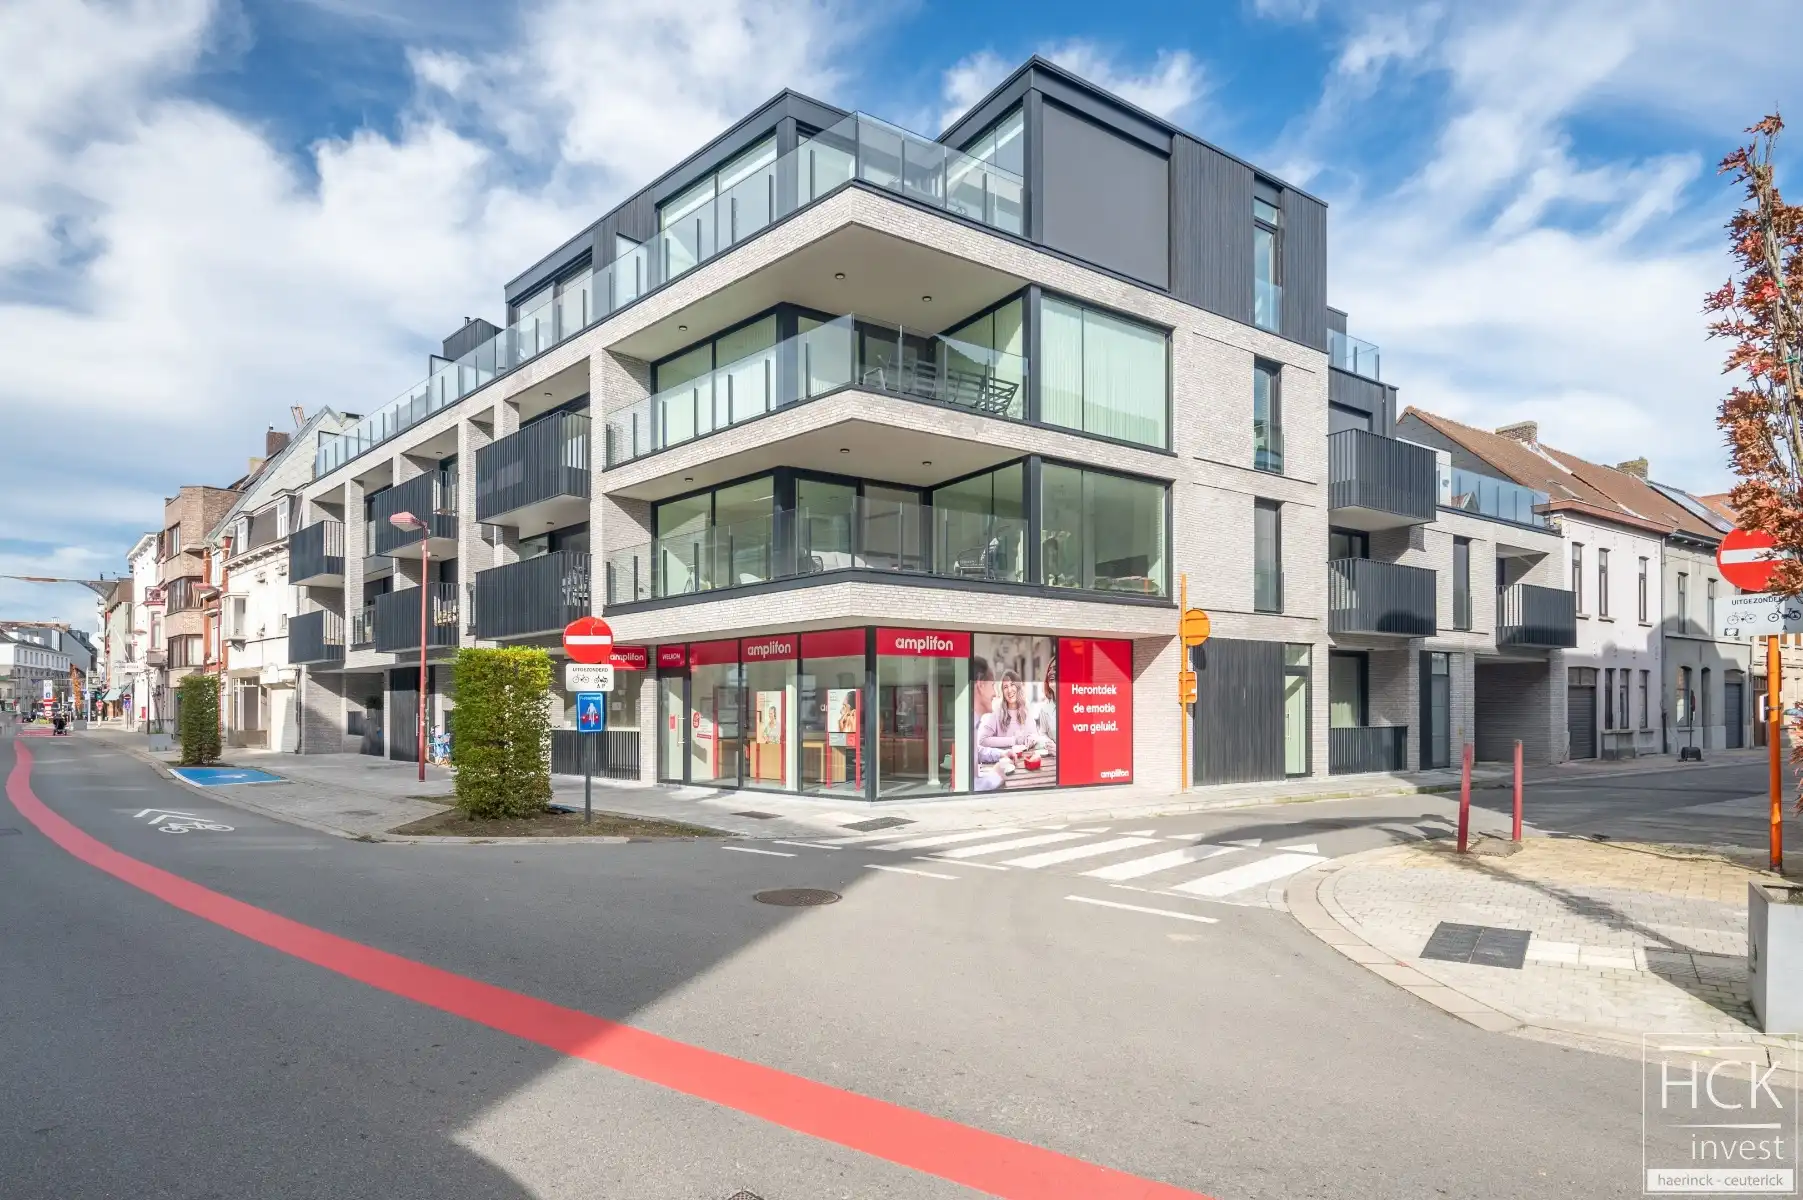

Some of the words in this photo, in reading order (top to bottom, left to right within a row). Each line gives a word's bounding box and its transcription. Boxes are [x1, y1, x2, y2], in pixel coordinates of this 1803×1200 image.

[1731, 595, 1789, 606] UITGEZONDED
[747, 640, 791, 658] amplifon
[895, 635, 954, 654] amplifon
[609, 650, 644, 663] amplifon
[1071, 684, 1117, 695] Herontdek
[1073, 703, 1085, 713] de
[1086, 703, 1116, 713] emotie
[1072, 723, 1089, 732] van
[1090, 721, 1119, 734] geluid.
[1100, 768, 1130, 780] amplifon
